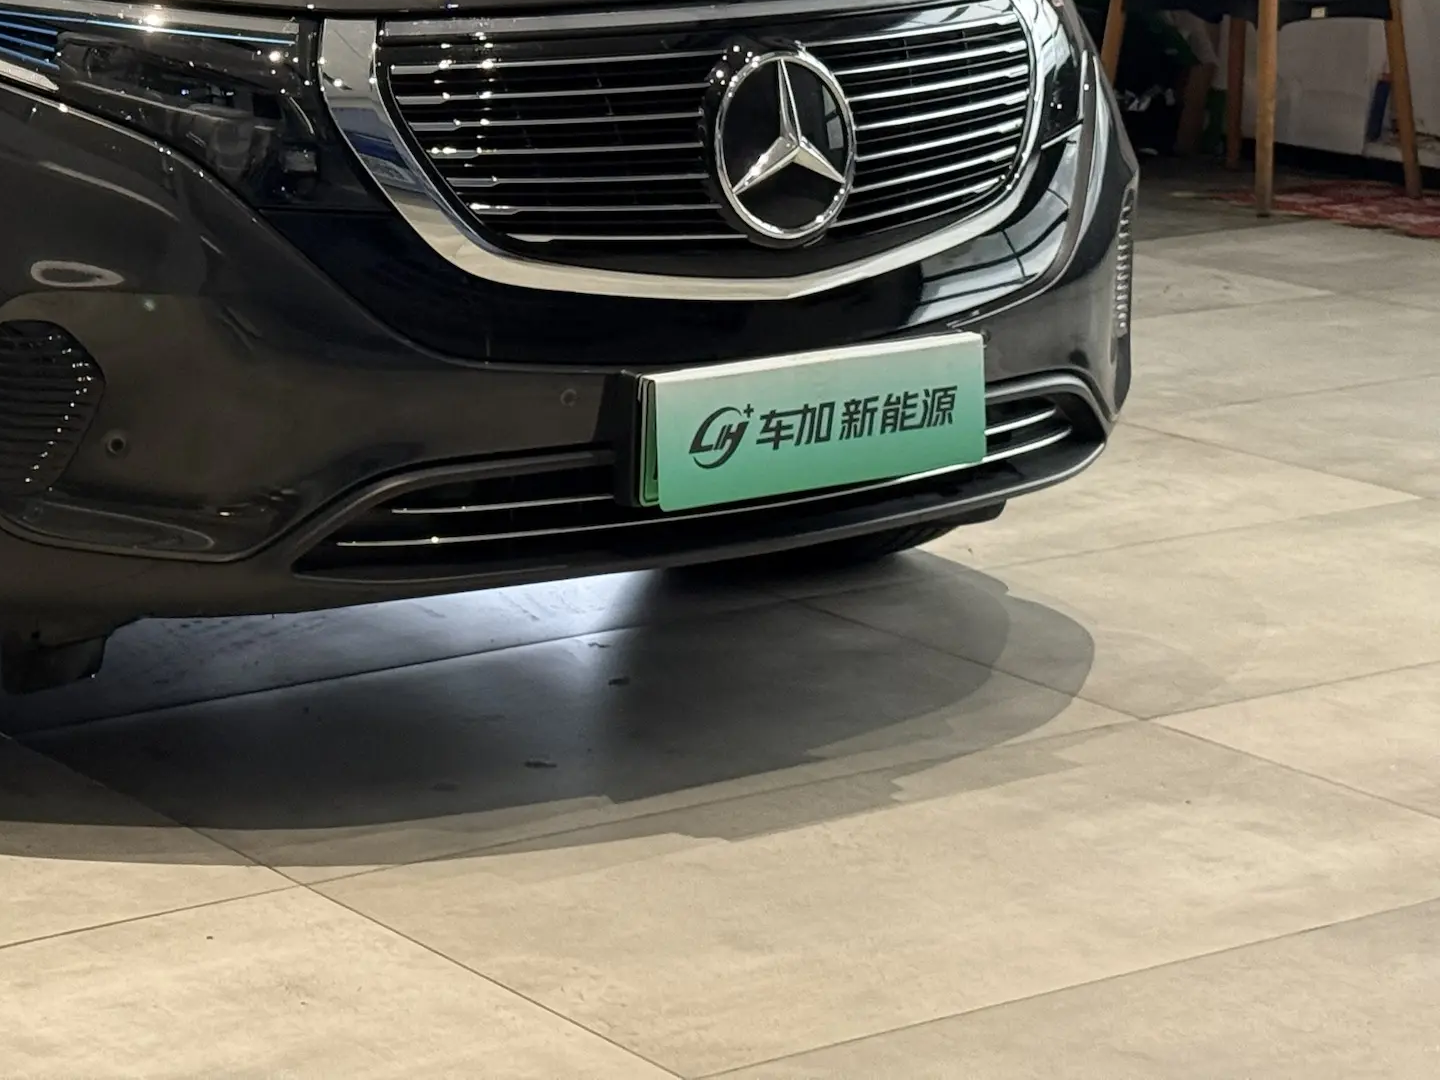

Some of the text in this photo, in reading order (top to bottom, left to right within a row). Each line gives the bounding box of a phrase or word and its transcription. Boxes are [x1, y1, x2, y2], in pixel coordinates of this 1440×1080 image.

[756, 386, 958, 451] 车加新能源
